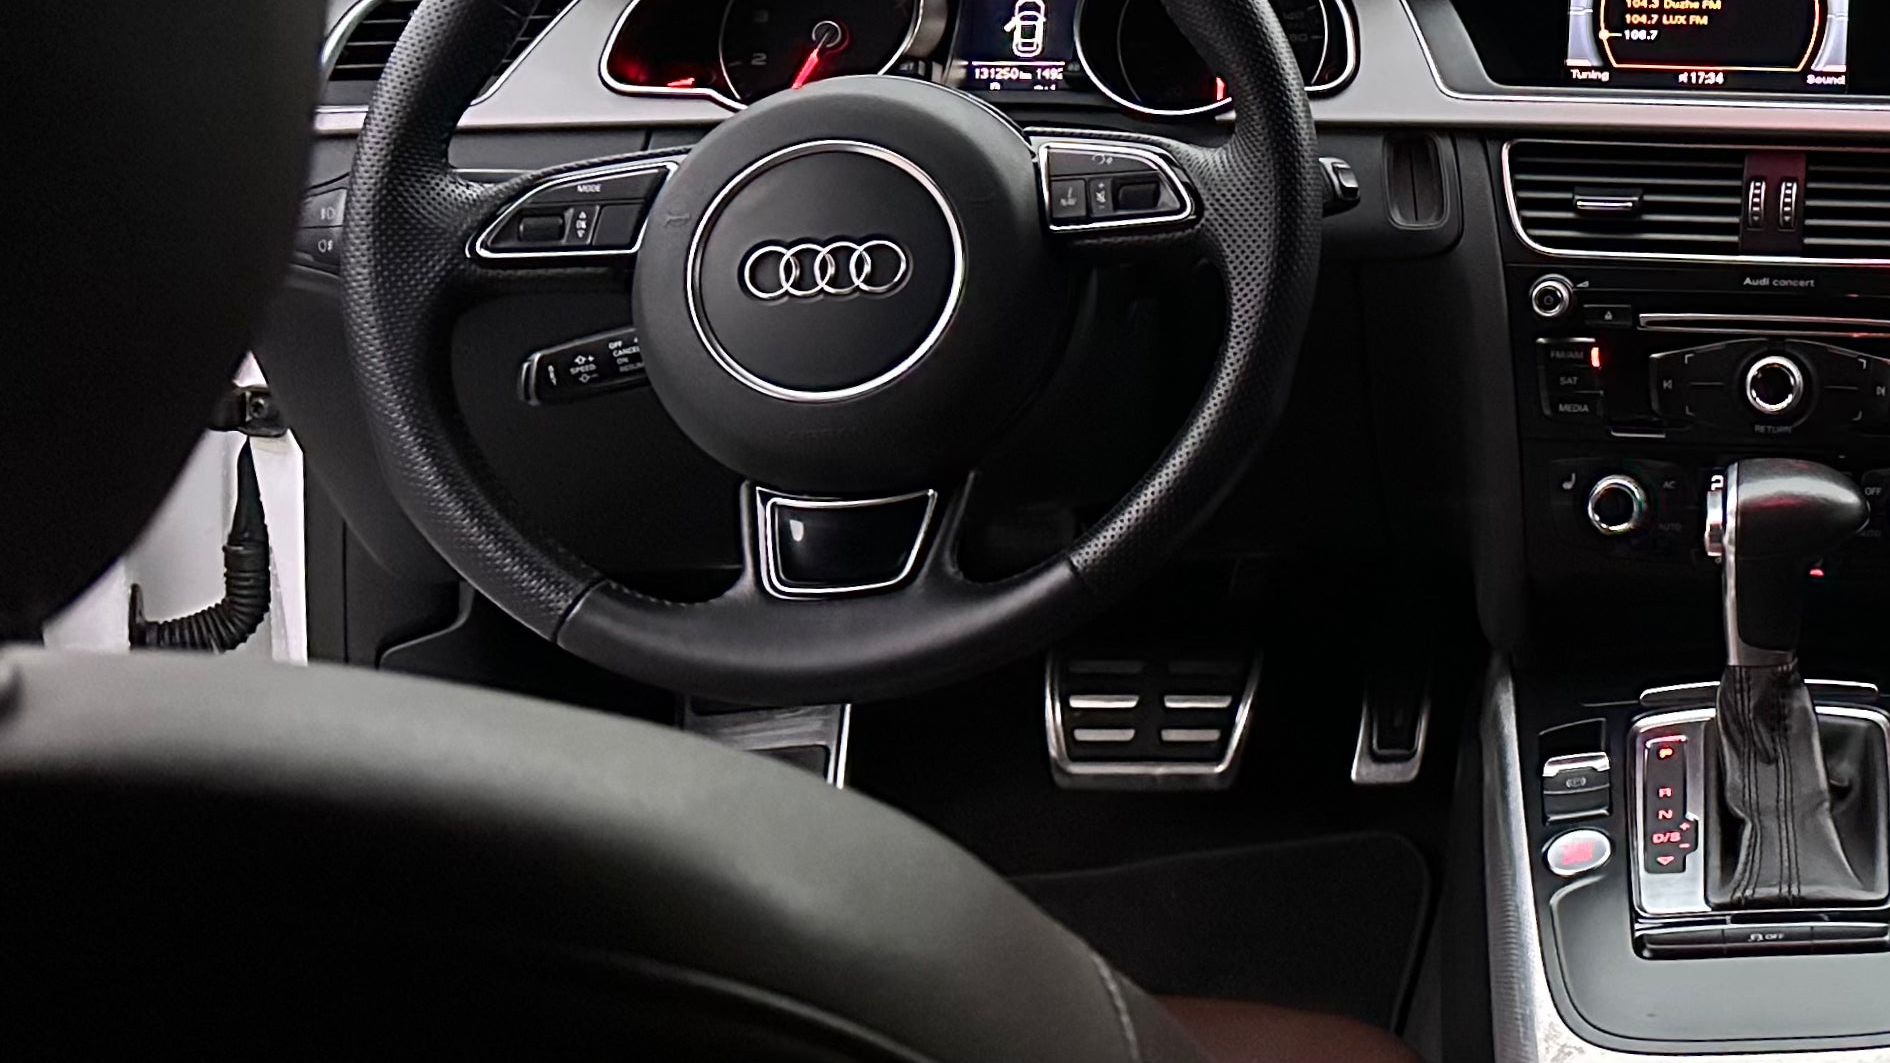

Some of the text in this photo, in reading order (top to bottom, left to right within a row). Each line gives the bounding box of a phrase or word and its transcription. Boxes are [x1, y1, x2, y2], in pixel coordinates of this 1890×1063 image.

[1702, 0, 1722, 10] FM
[1625, 14, 1709, 25] 104.7 LUX FM
[750, 52, 767, 65] 2
[1570, 69, 1609, 82] Tuning
[1690, 72, 1724, 85] 17:34
[1806, 74, 1846, 85] Sound
[1743, 277, 1815, 288] Audi concert
[1559, 376, 1578, 386] SAT
[1558, 402, 1590, 413] MEDIA
[1864, 486, 1883, 496] OFF
[1658, 809, 1673, 820] N
